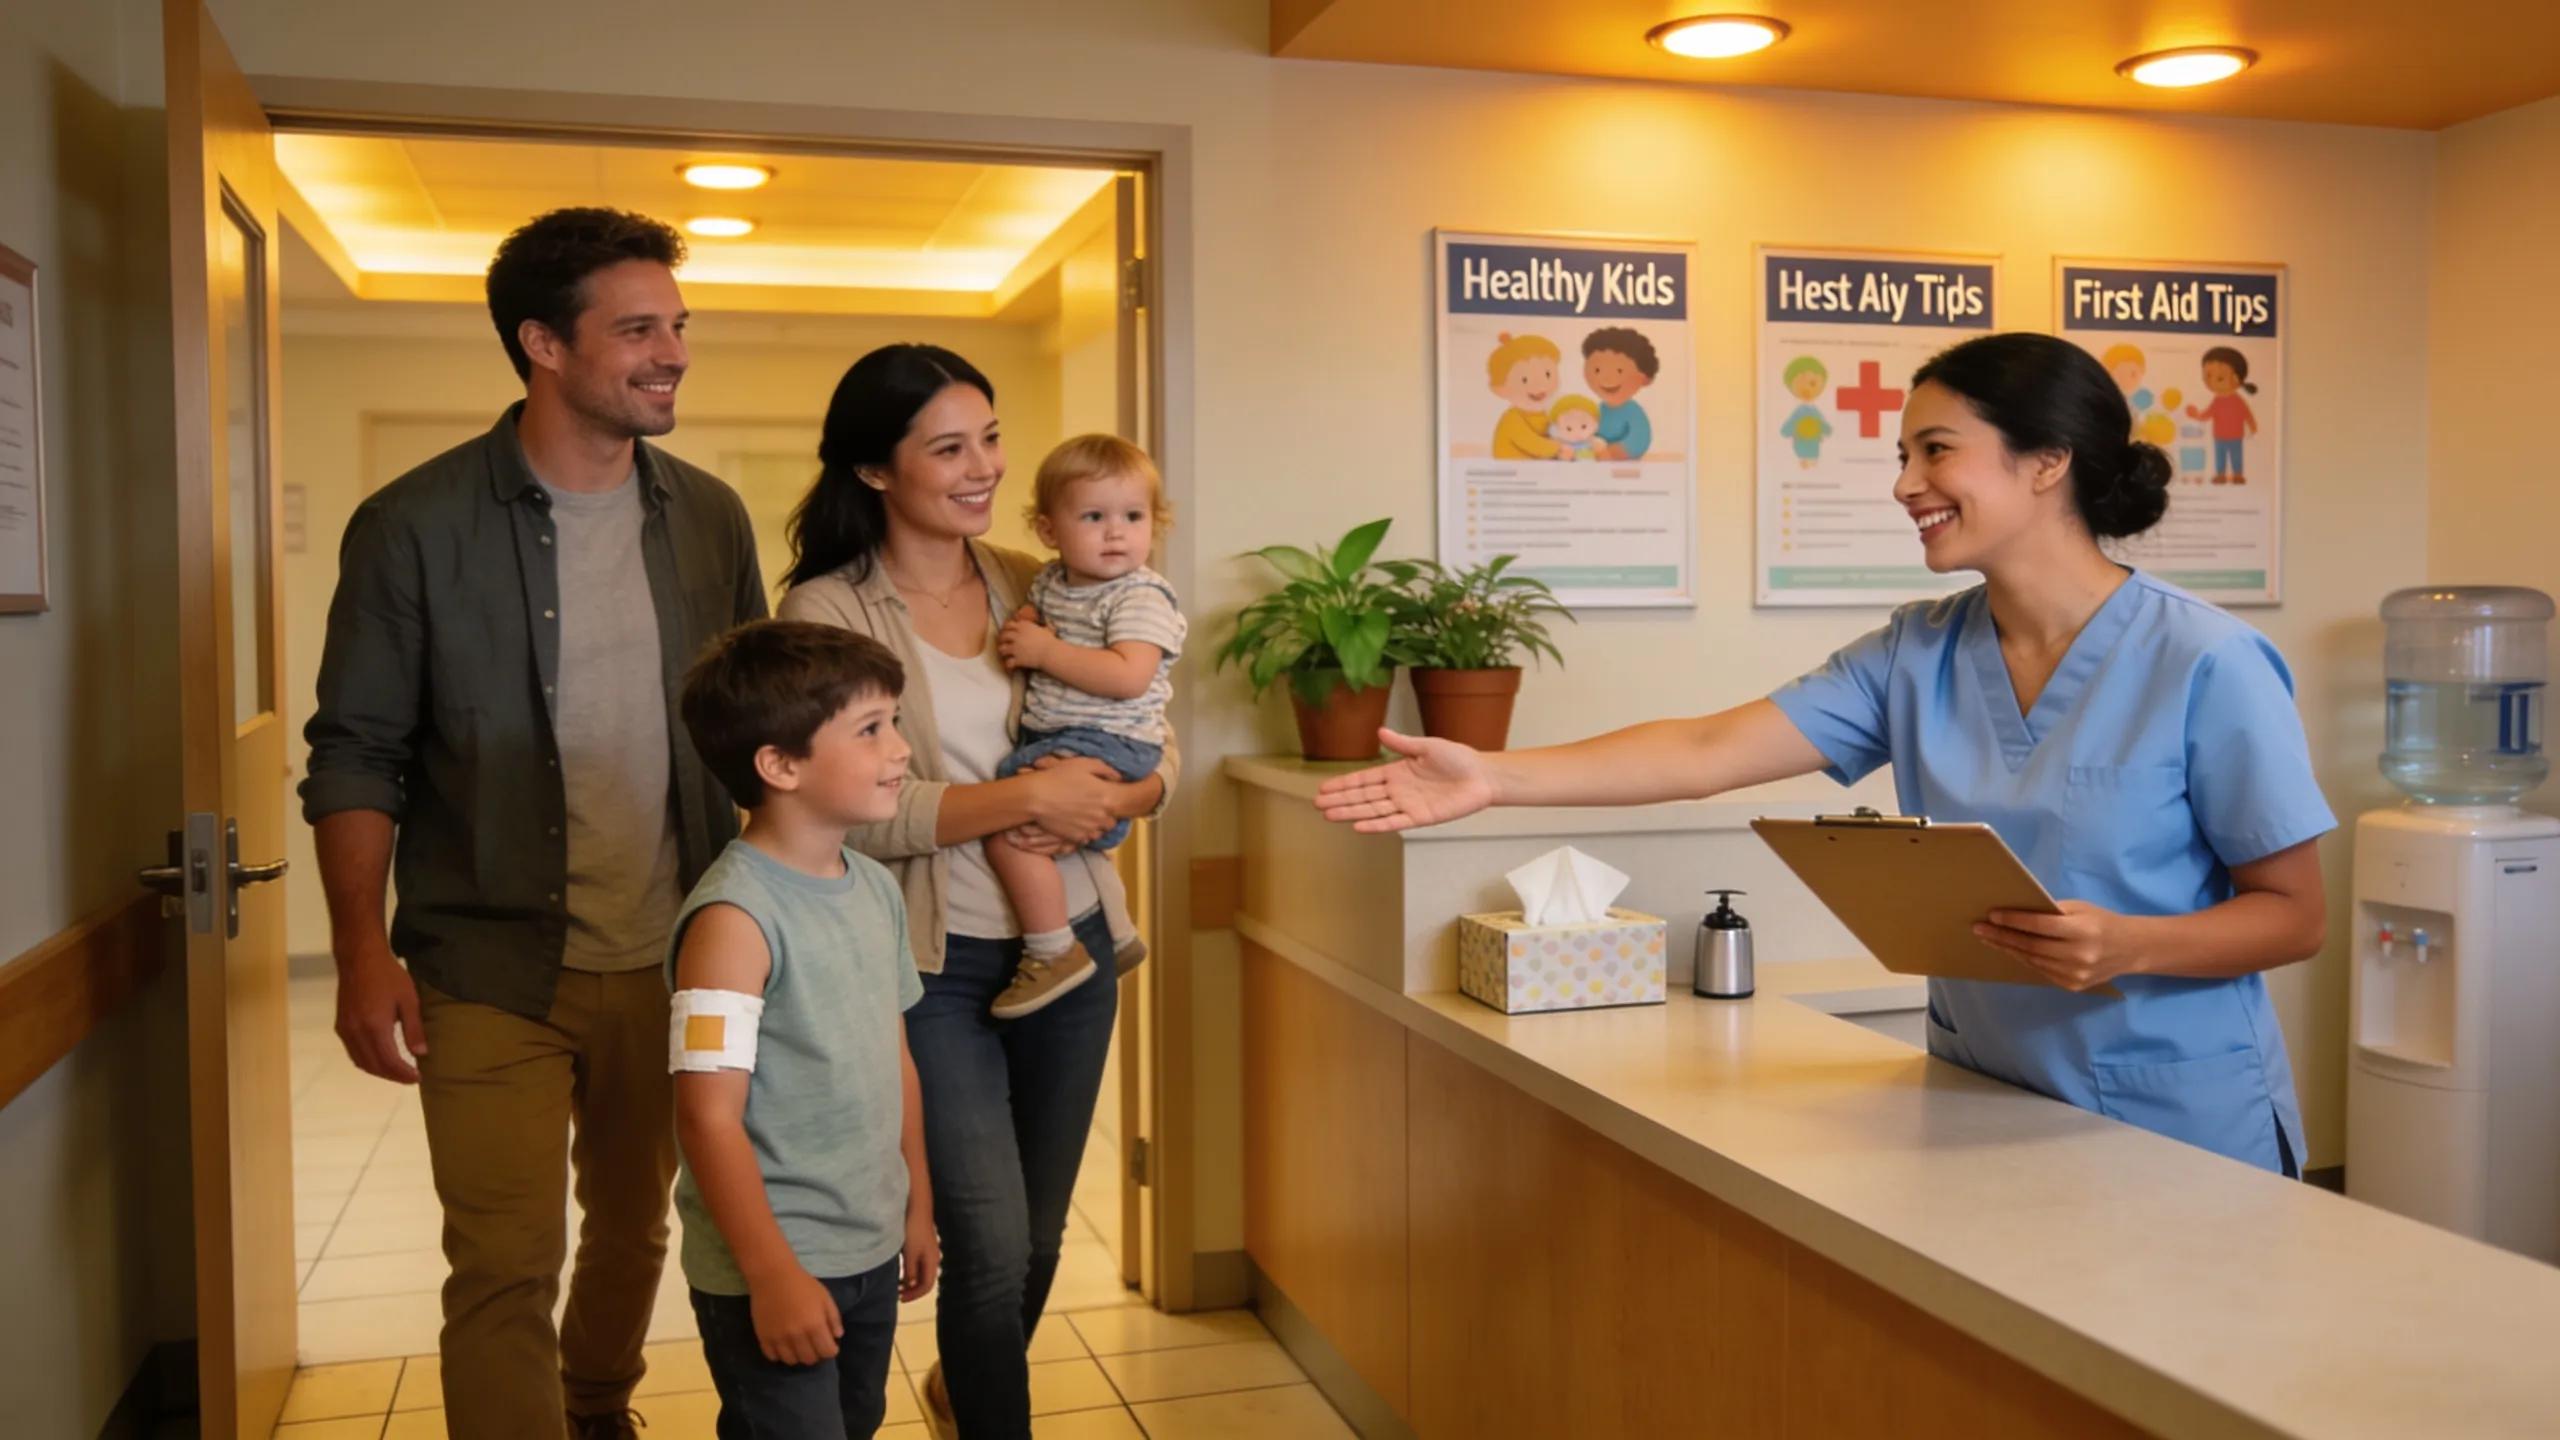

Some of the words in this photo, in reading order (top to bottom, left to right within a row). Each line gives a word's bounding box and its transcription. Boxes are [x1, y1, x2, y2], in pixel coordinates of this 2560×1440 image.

[1463, 257, 1594, 314] Healthy
[1603, 262, 1675, 306] Kids
[1779, 269, 1853, 312] Hest
[2073, 279, 2144, 321] First
[2150, 281, 2199, 323] Aid
[2205, 283, 2269, 334] Tips
